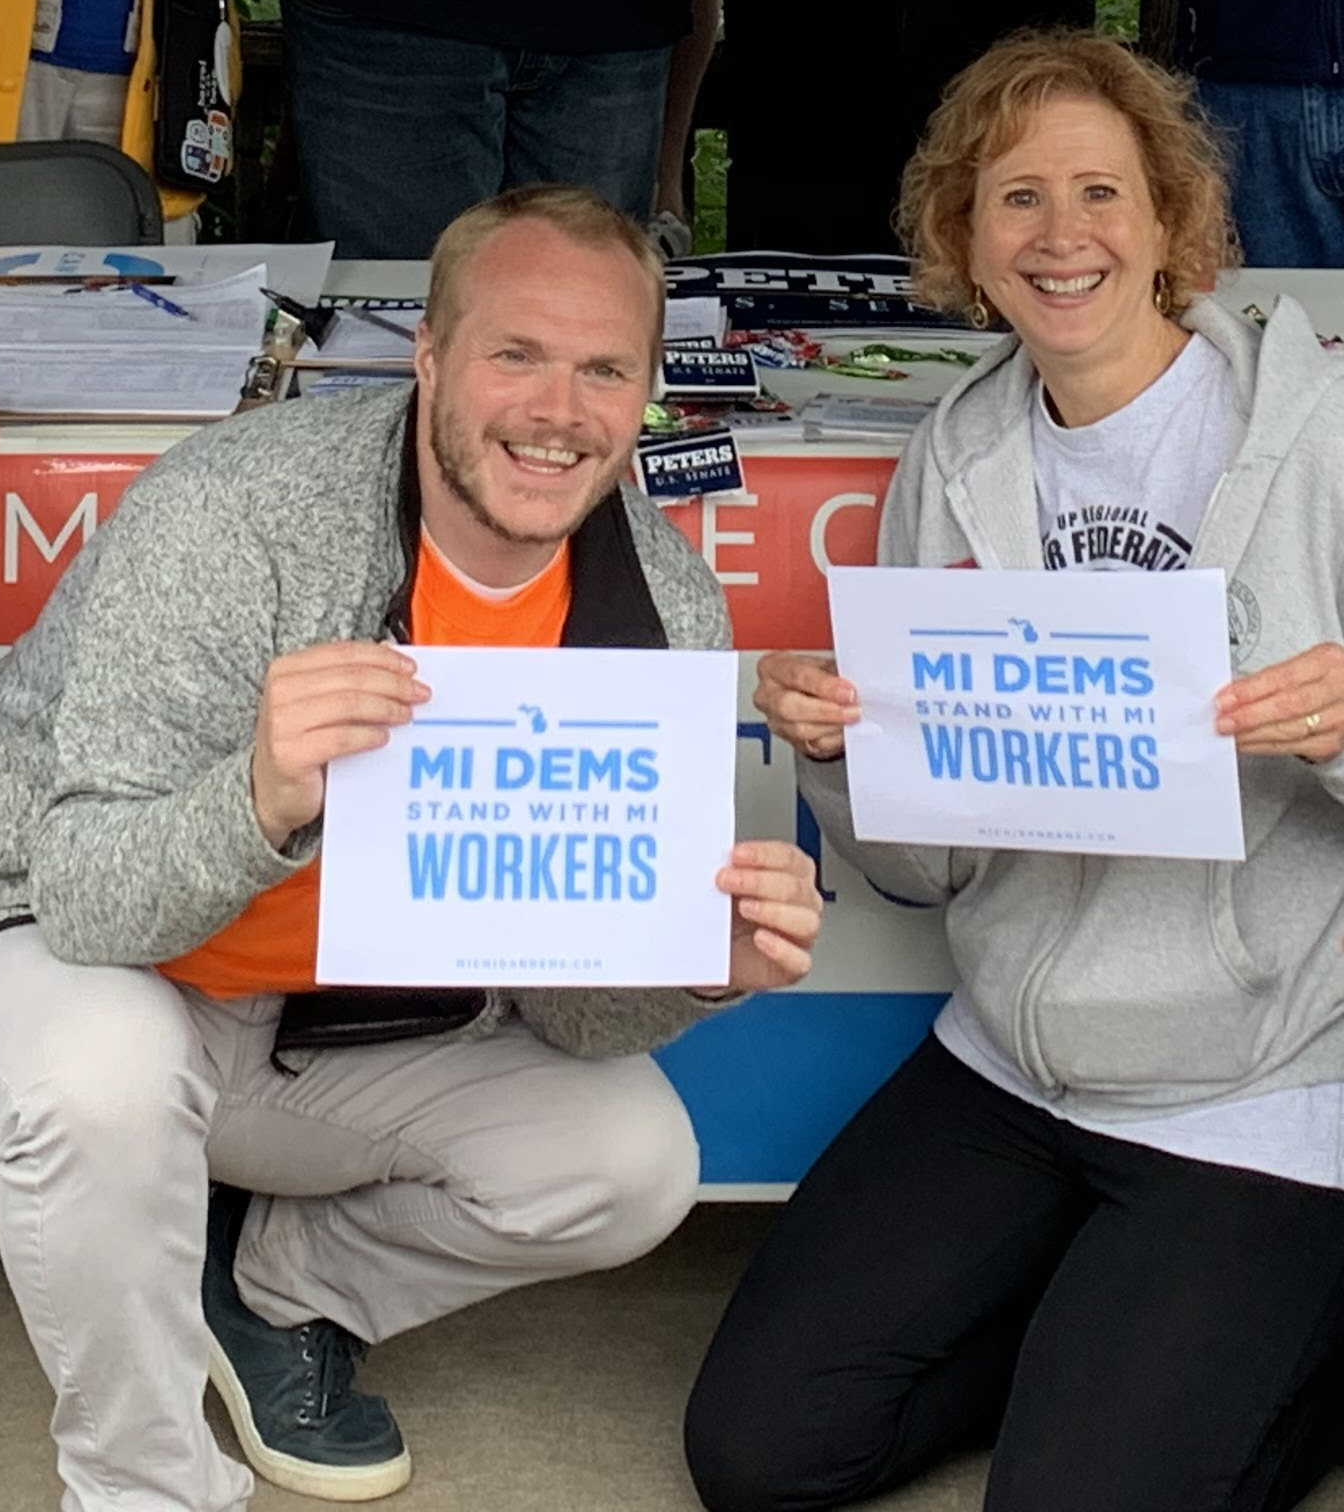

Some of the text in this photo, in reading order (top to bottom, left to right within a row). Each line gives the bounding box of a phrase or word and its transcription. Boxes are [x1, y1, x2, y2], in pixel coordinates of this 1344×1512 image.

[664, 266, 914, 295] PETE
[665, 350, 748, 366] PETERS
[645, 444, 734, 475] PETERS
[684, 464, 732, 482] SENATE
[1057, 511, 1078, 531] UP
[912, 652, 1154, 696] MI DEMS
[916, 700, 1155, 725] STAND WITH MI
[409, 747, 659, 792] MI DEMS
[920, 723, 1160, 790] WORKERS
[408, 802, 658, 822] STAND WITH MI
[408, 833, 657, 901] WORKERS
